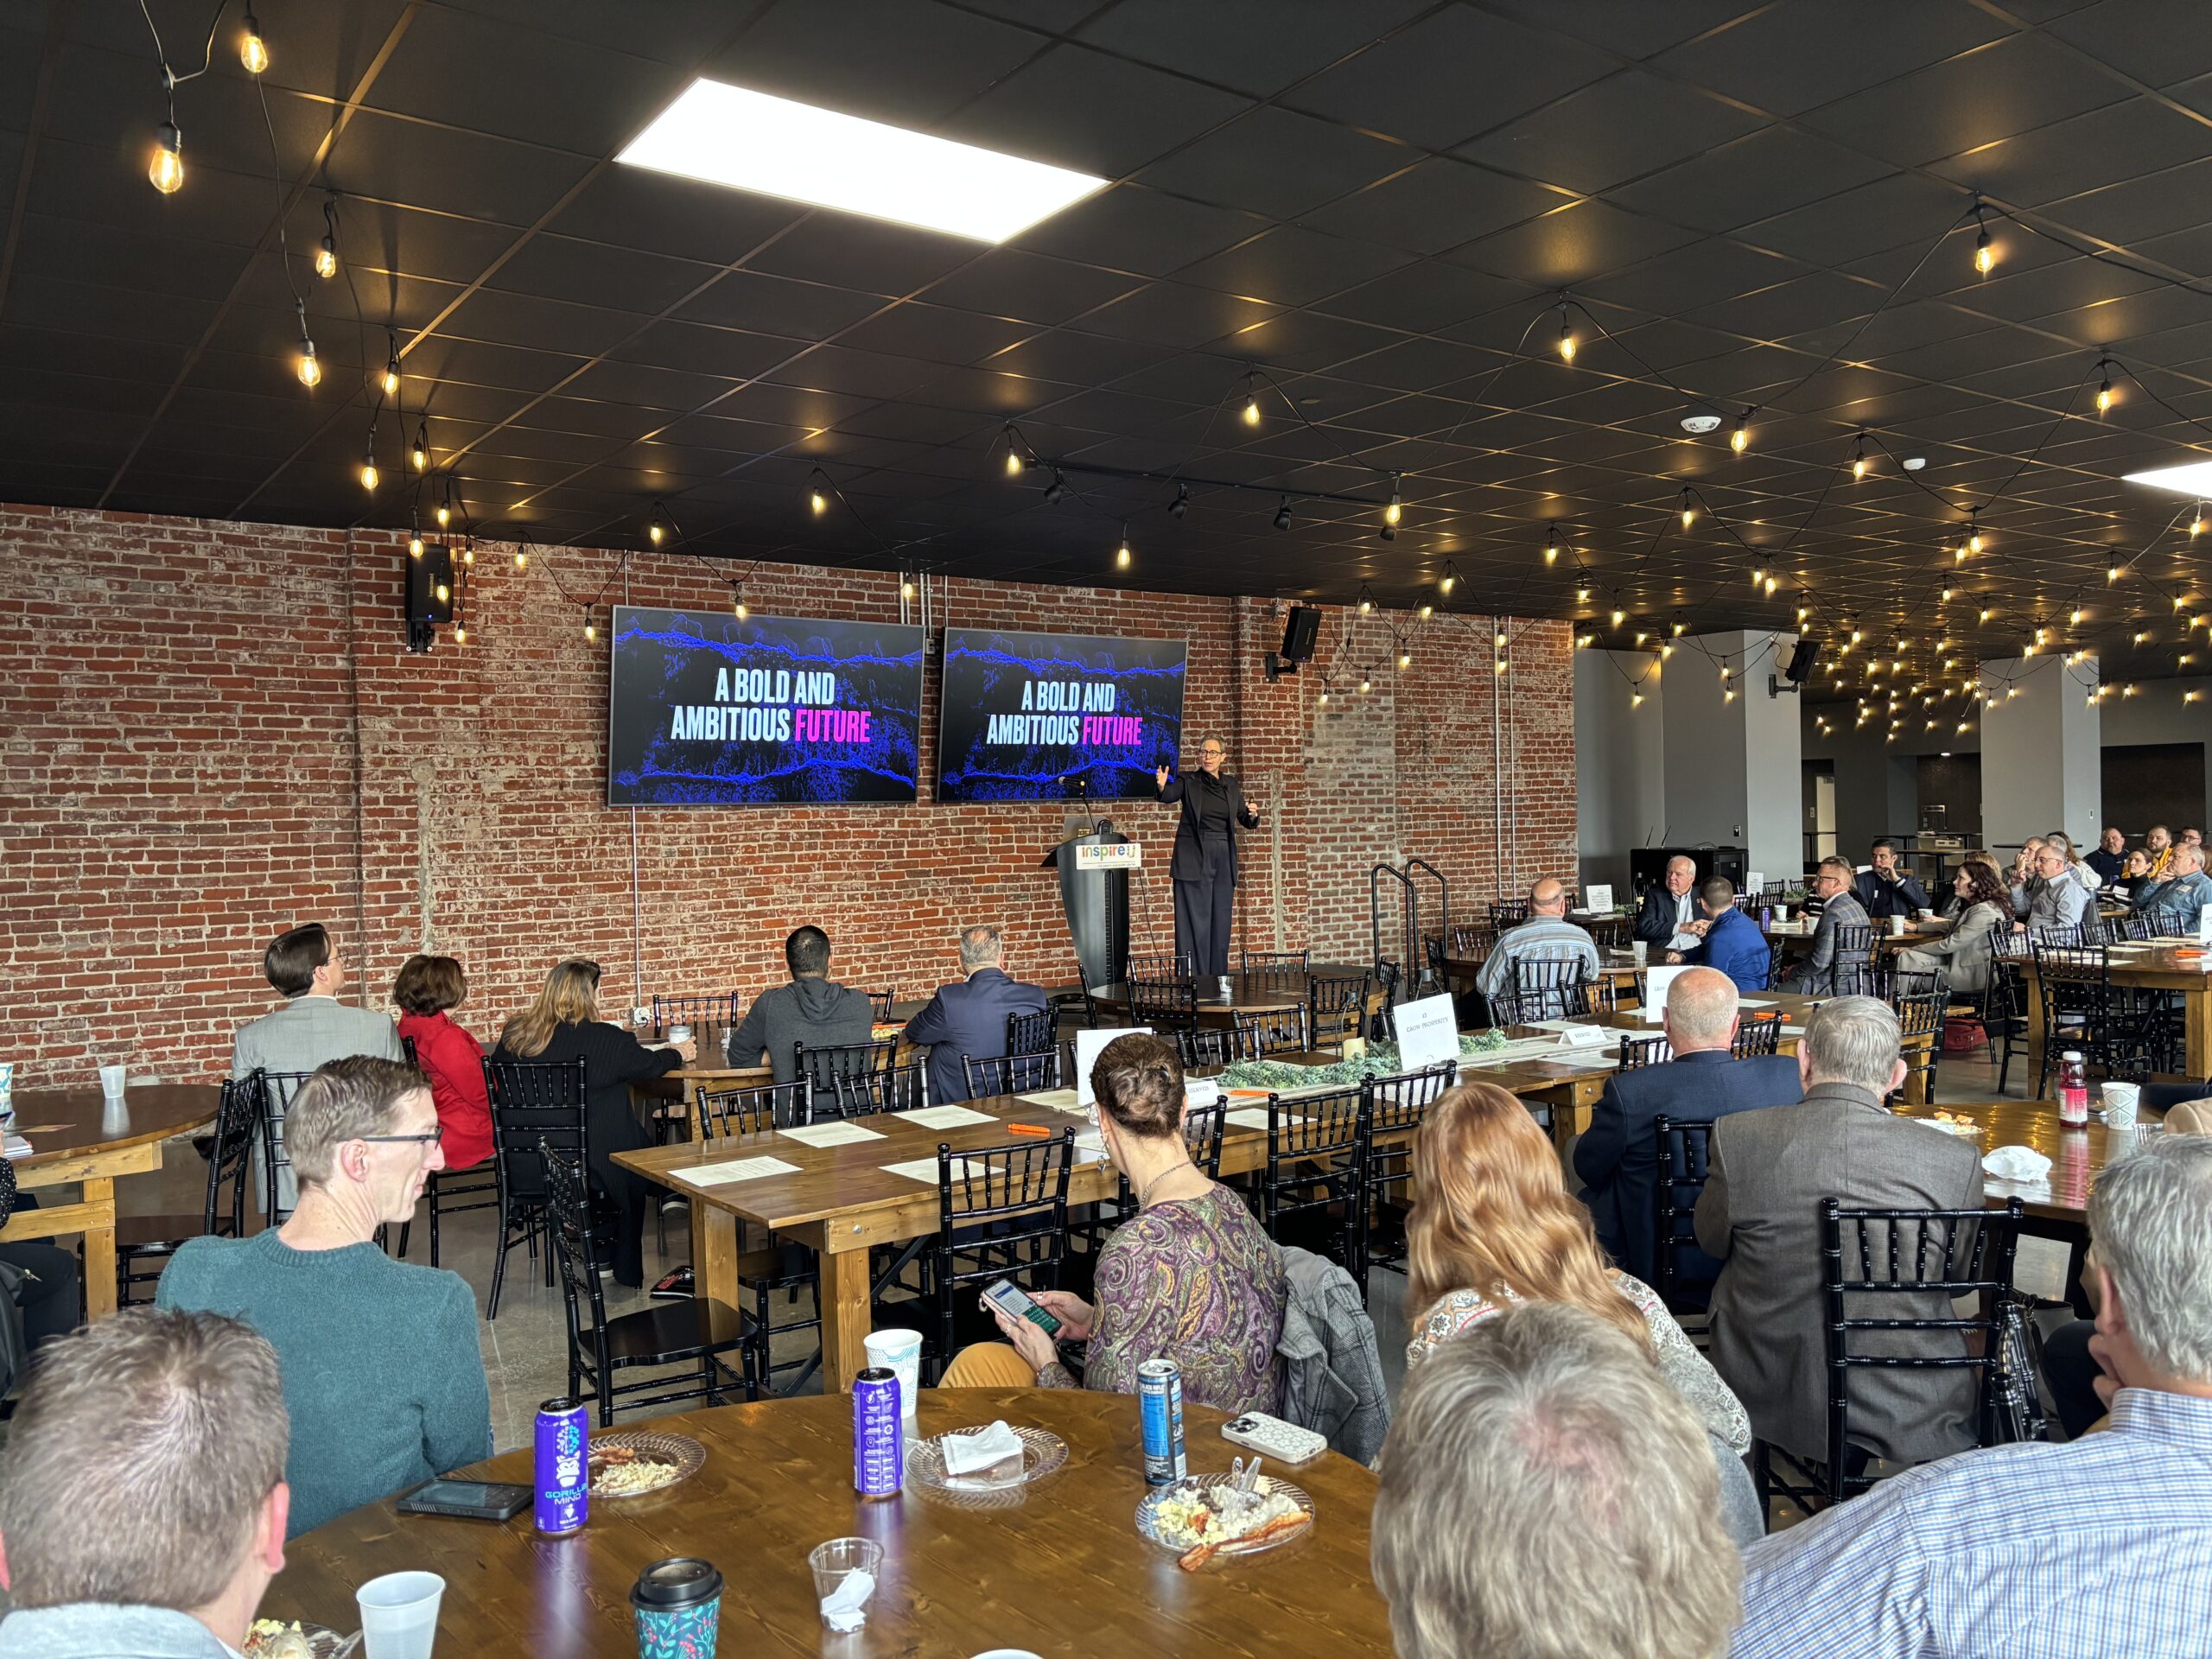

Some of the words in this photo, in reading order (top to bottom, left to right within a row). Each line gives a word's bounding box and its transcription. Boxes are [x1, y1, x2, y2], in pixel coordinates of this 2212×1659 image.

[715, 667, 729, 702] A
[734, 668, 790, 703] BOLD
[793, 671, 836, 705] AND
[1021, 680, 1033, 711] A
[1036, 681, 1080, 712] BOLD
[1082, 682, 1116, 712] AND
[671, 705, 791, 741] AMBITIOUS
[794, 709, 871, 742] FUTURE
[986, 714, 1079, 745] AMBITIOUS
[1082, 716, 1143, 745] FUTURE
[554, 1493, 582, 1505] MIND
